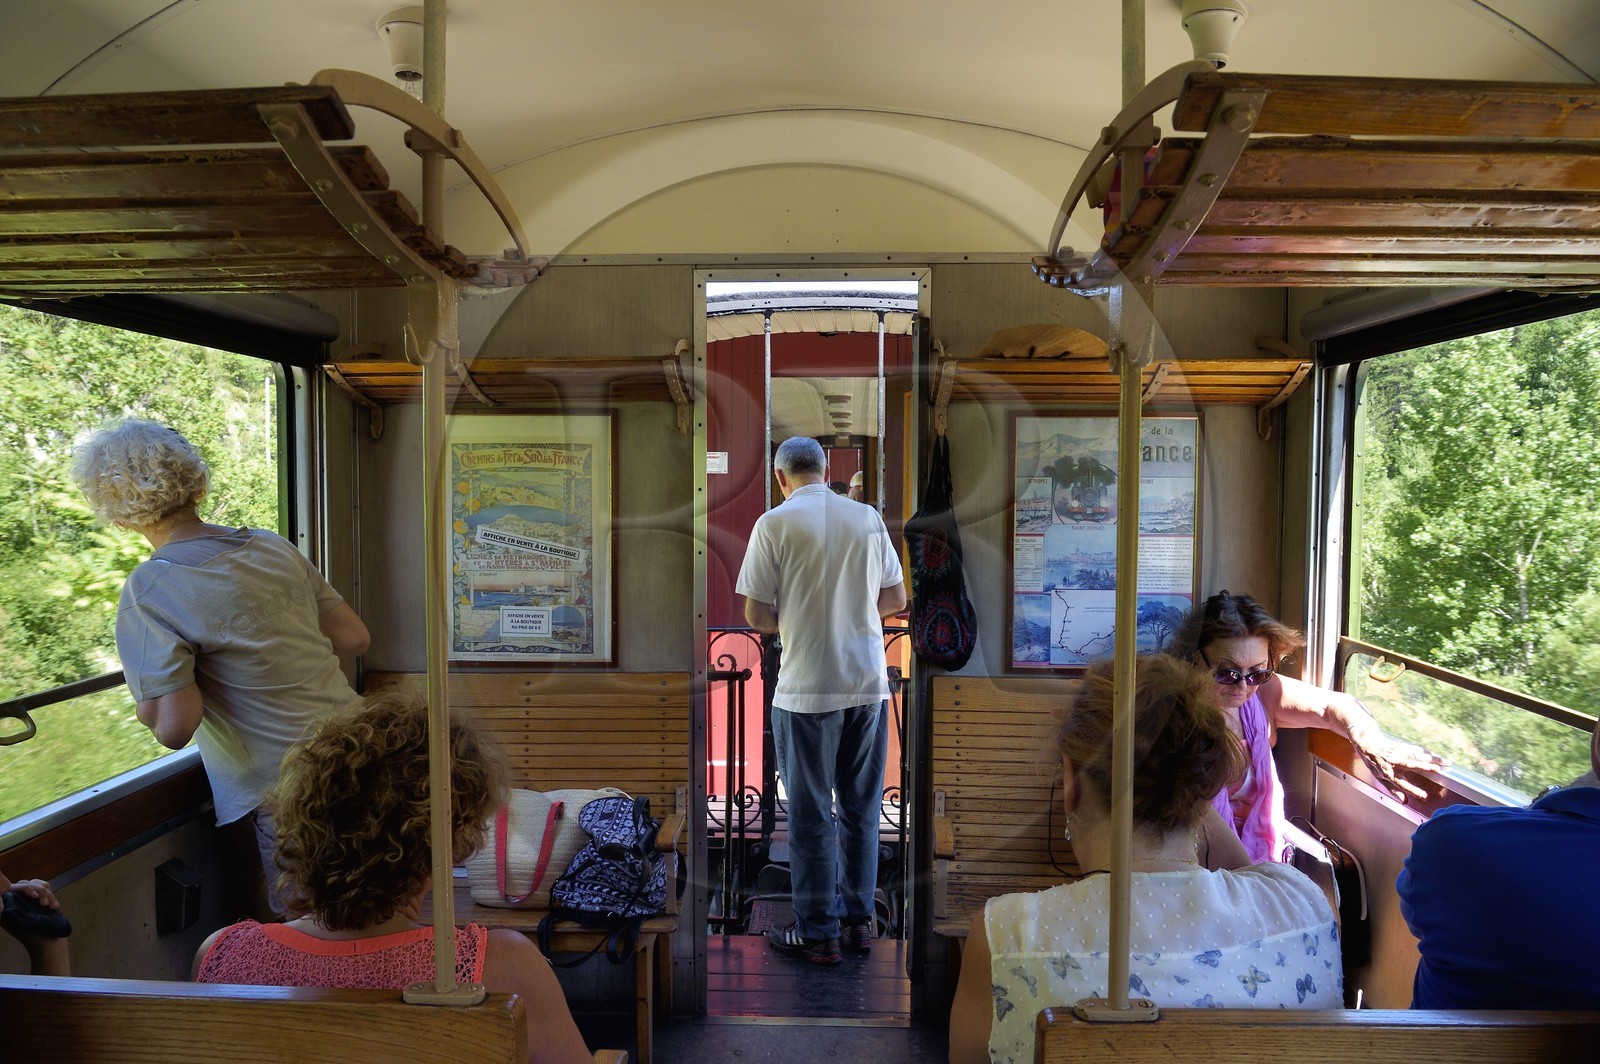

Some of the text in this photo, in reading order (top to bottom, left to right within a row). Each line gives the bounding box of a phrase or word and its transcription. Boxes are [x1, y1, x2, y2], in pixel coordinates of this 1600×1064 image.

[1151, 426, 1173, 435] de la
[1142, 445, 1192, 462] ance
[483, 532, 507, 543] AFFICHE
[516, 538, 534, 548] VENTE
[540, 544, 548, 552] LA
[548, 546, 578, 558] BOUTIQUE
